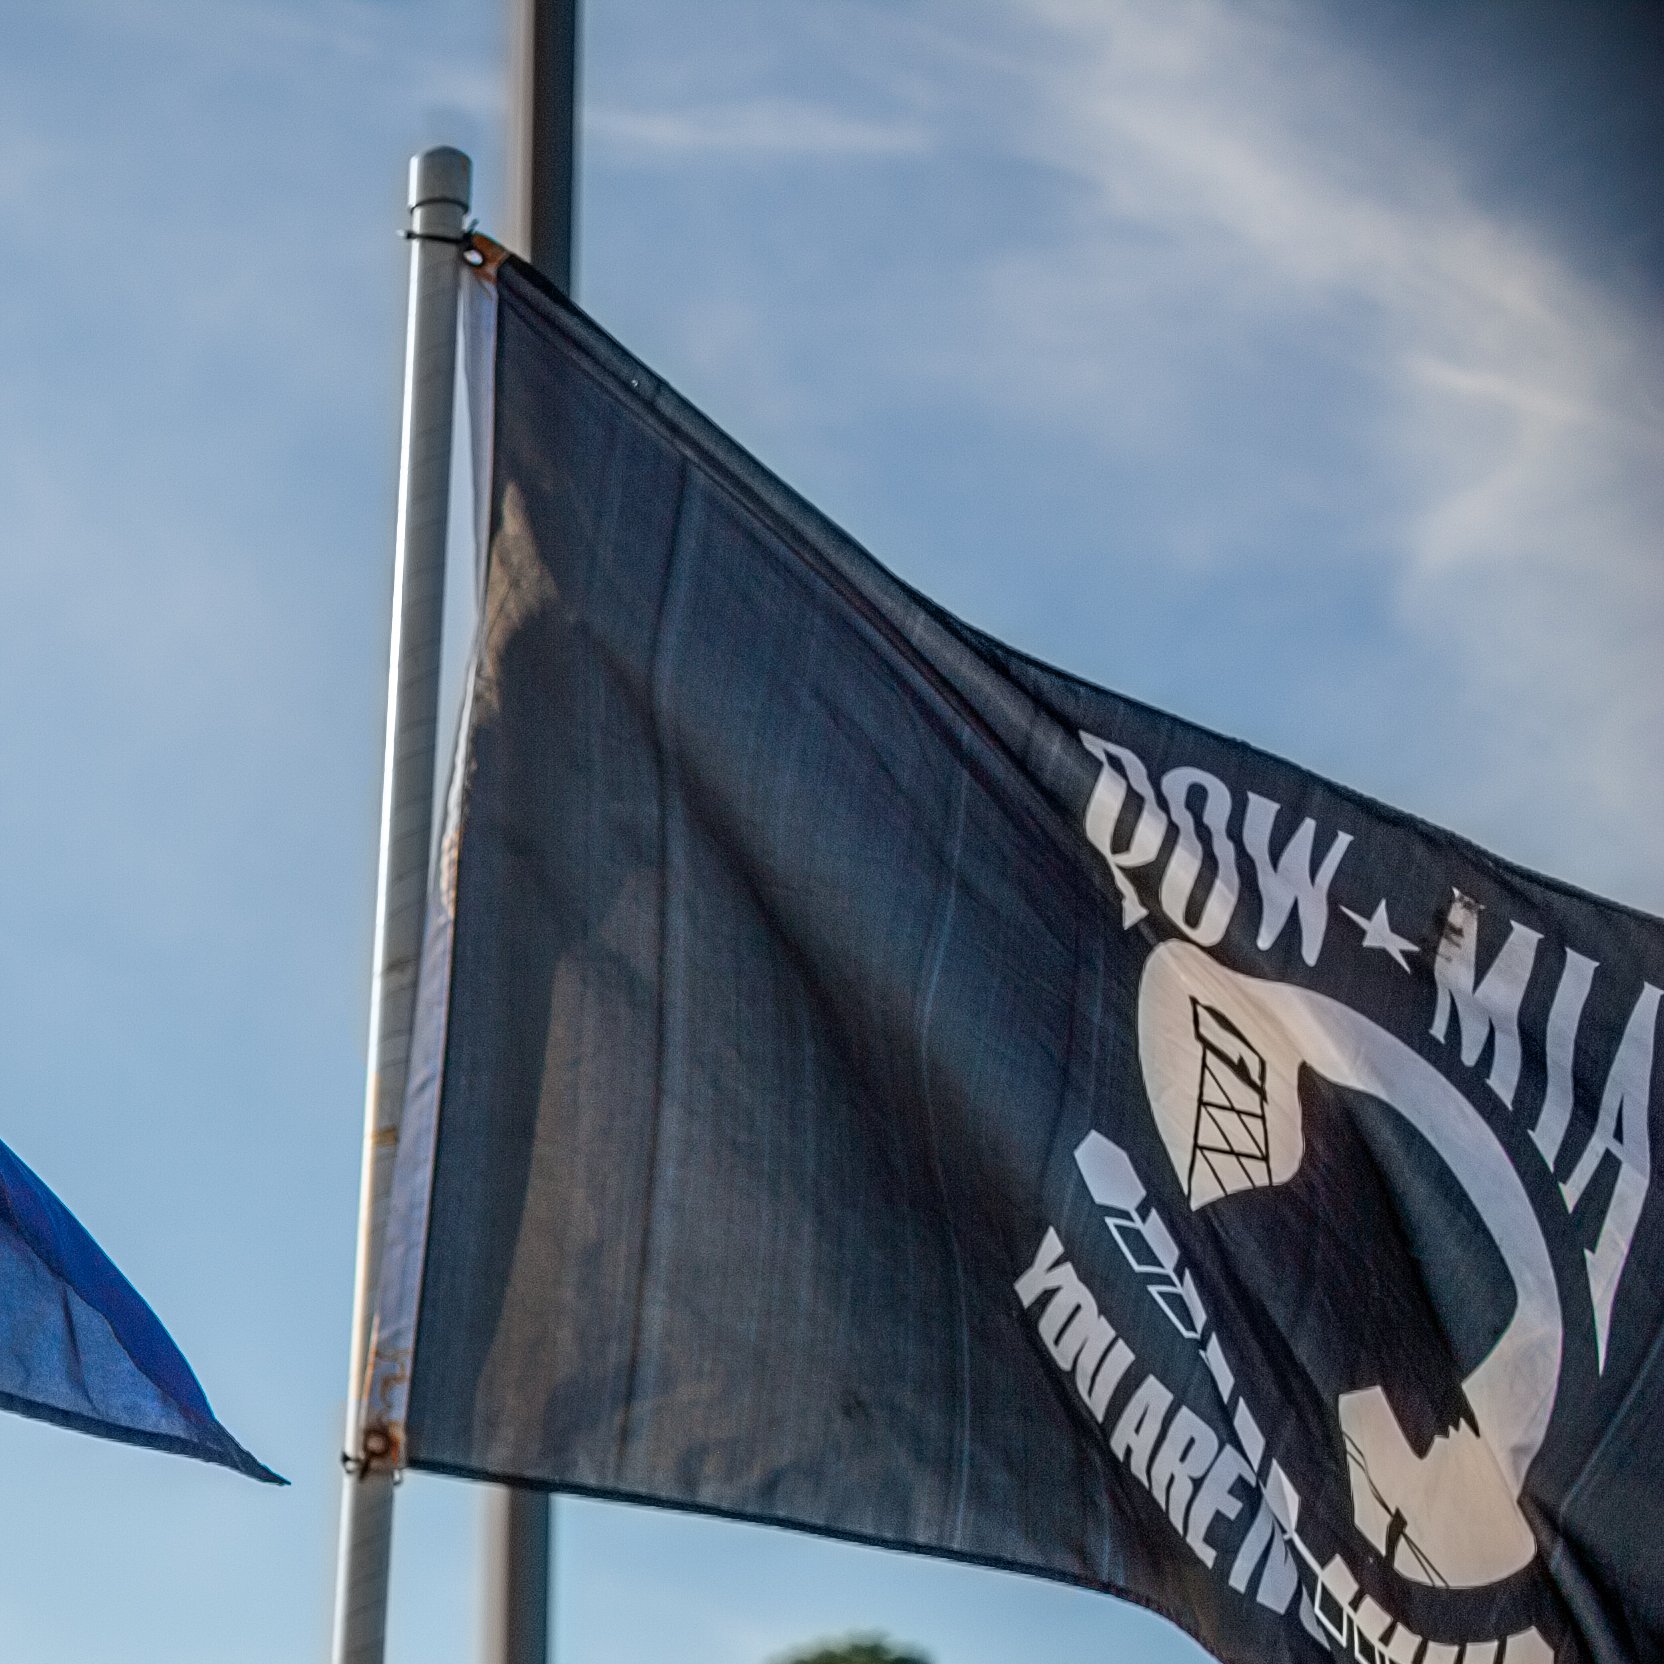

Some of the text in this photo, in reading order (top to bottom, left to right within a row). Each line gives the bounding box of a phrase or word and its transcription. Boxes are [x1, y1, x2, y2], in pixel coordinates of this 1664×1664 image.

[1078, 730, 1664, 1377] POW MIA
[1013, 1225, 1256, 1568] YOU ARE
